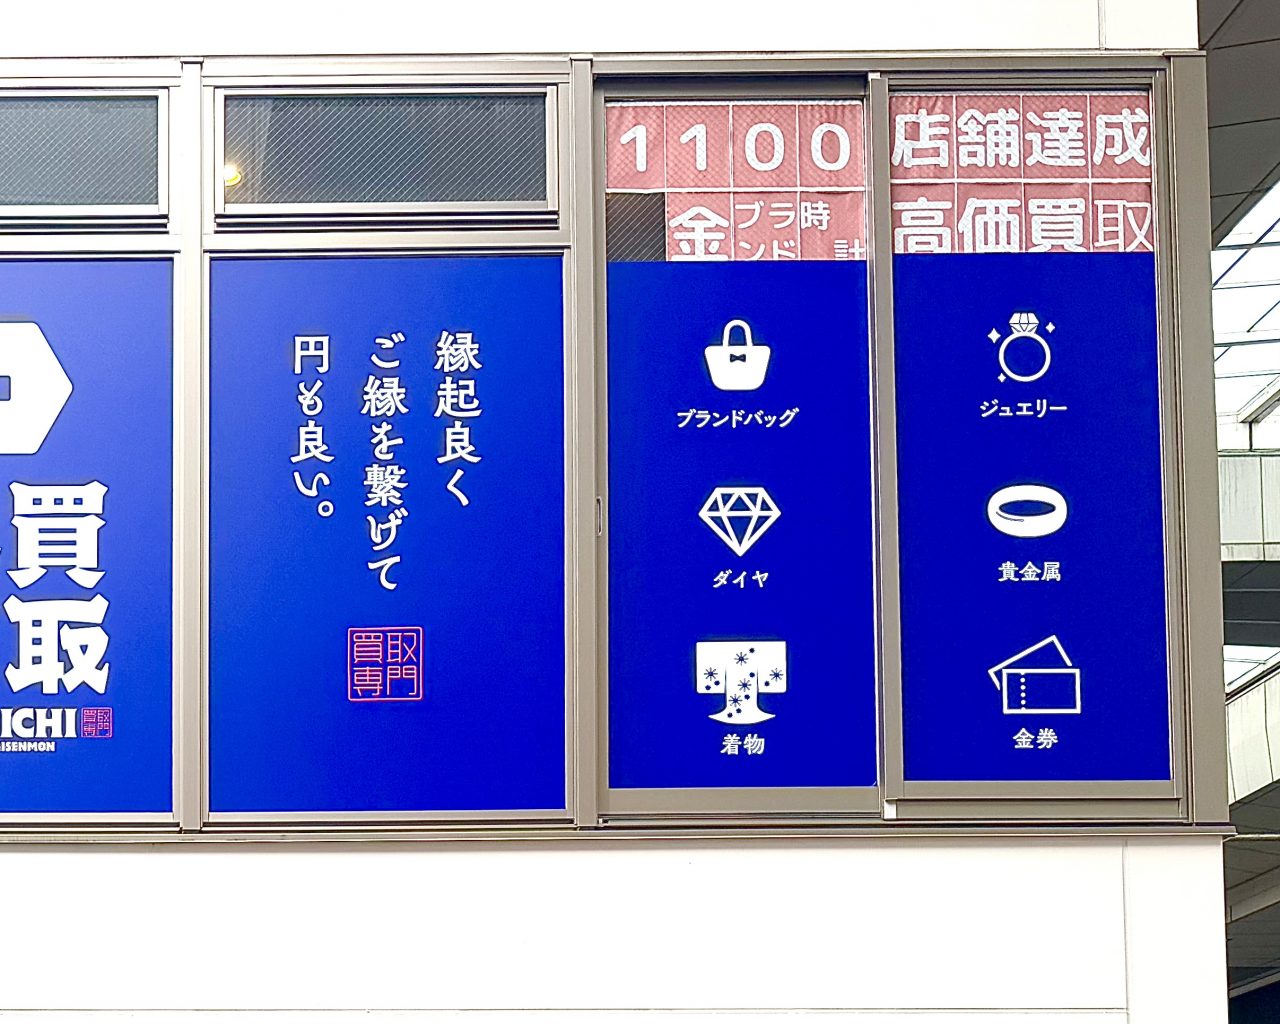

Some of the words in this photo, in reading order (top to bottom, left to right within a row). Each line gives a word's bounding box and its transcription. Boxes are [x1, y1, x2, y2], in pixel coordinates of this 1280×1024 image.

[619, 122, 851, 172] 1100
[891, 107, 1150, 169] 店舗達成
[669, 205, 730, 260] 金
[892, 196, 1153, 252] 高価買取
[433, 330, 483, 507] 縁起良く
[677, 407, 799, 429] ブランドバッグ
[979, 399, 1068, 418] ジュエリー
[290, 335, 335, 517] 円も良い。
[360, 332, 409, 590] ご縁を繋げて
[712, 569, 769, 589] ダイヤ
[998, 561, 1061, 582] 貴金属
[721, 733, 765, 755] 着物
[1012, 727, 1058, 750] 金券
